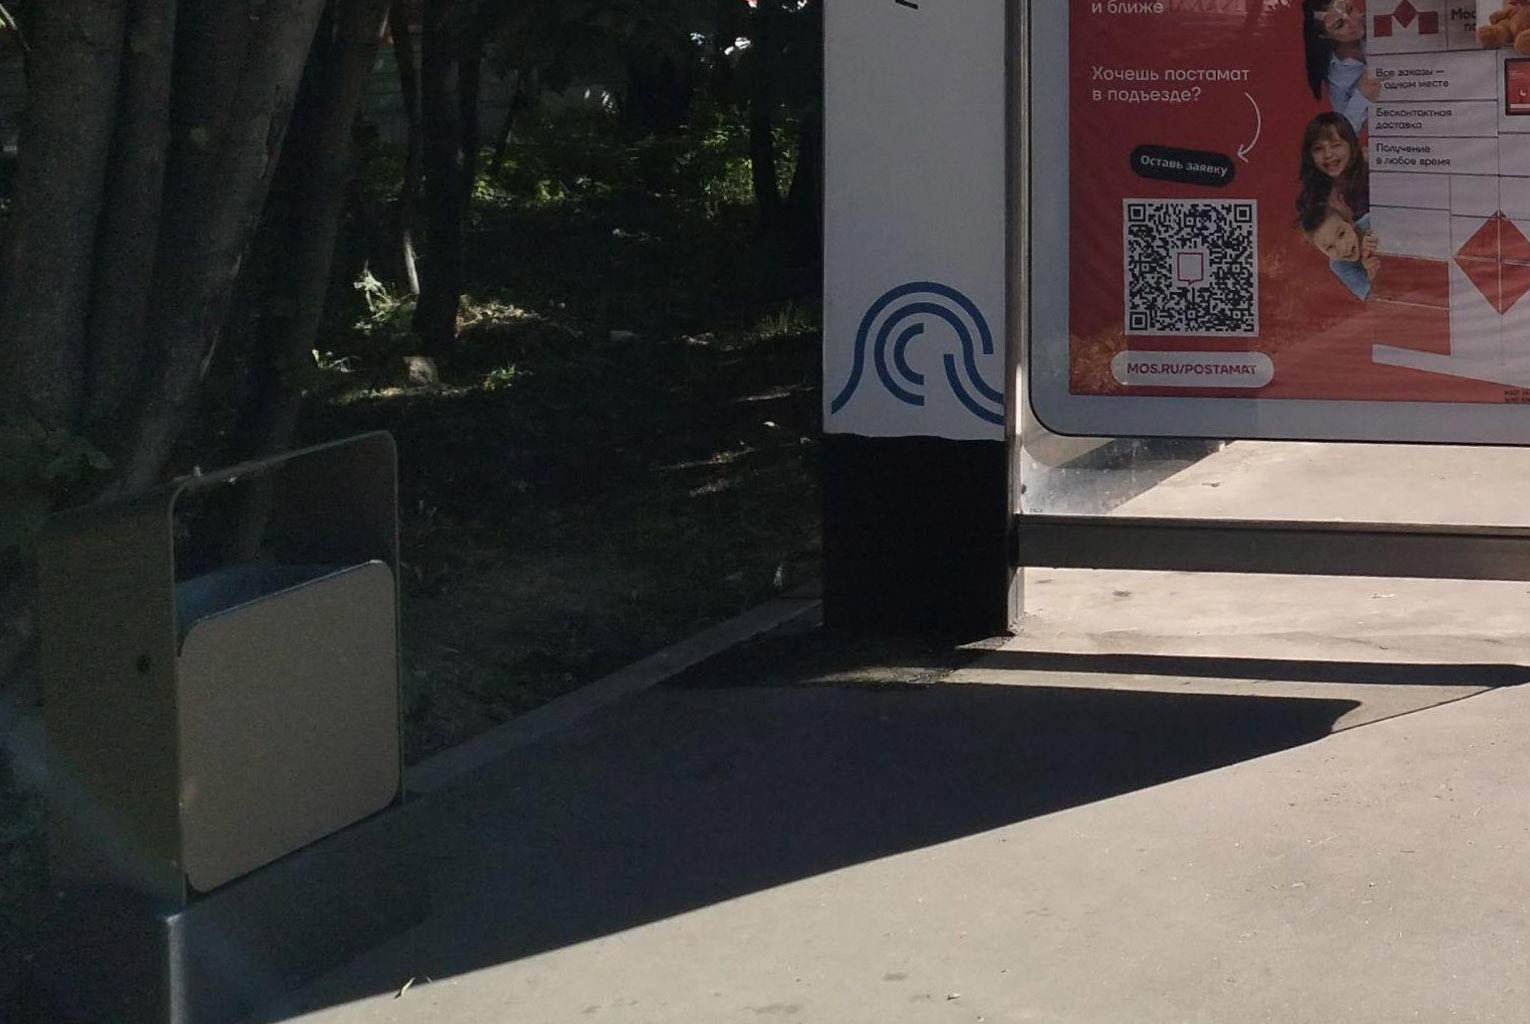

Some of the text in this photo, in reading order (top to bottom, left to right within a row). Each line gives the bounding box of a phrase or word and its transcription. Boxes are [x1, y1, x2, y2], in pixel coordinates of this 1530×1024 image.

[1091, 0, 1165, 14] и ближе
[1091, 65, 1250, 81] Хочешь постамат
[1375, 68, 1395, 77] Все
[1397, 68, 1433, 76] заказы
[1092, 89, 1102, 101] в
[1375, 107, 1452, 117] Бесконтактная
[1375, 121, 1423, 130] доставка
[1376, 142, 1431, 154] Получение
[1140, 154, 1228, 177] Оставь заявку
[1384, 156, 1417, 165] любое
[1419, 158, 1451, 167] время
[1126, 362, 1257, 375] MOS.RU/POSTAMAT
